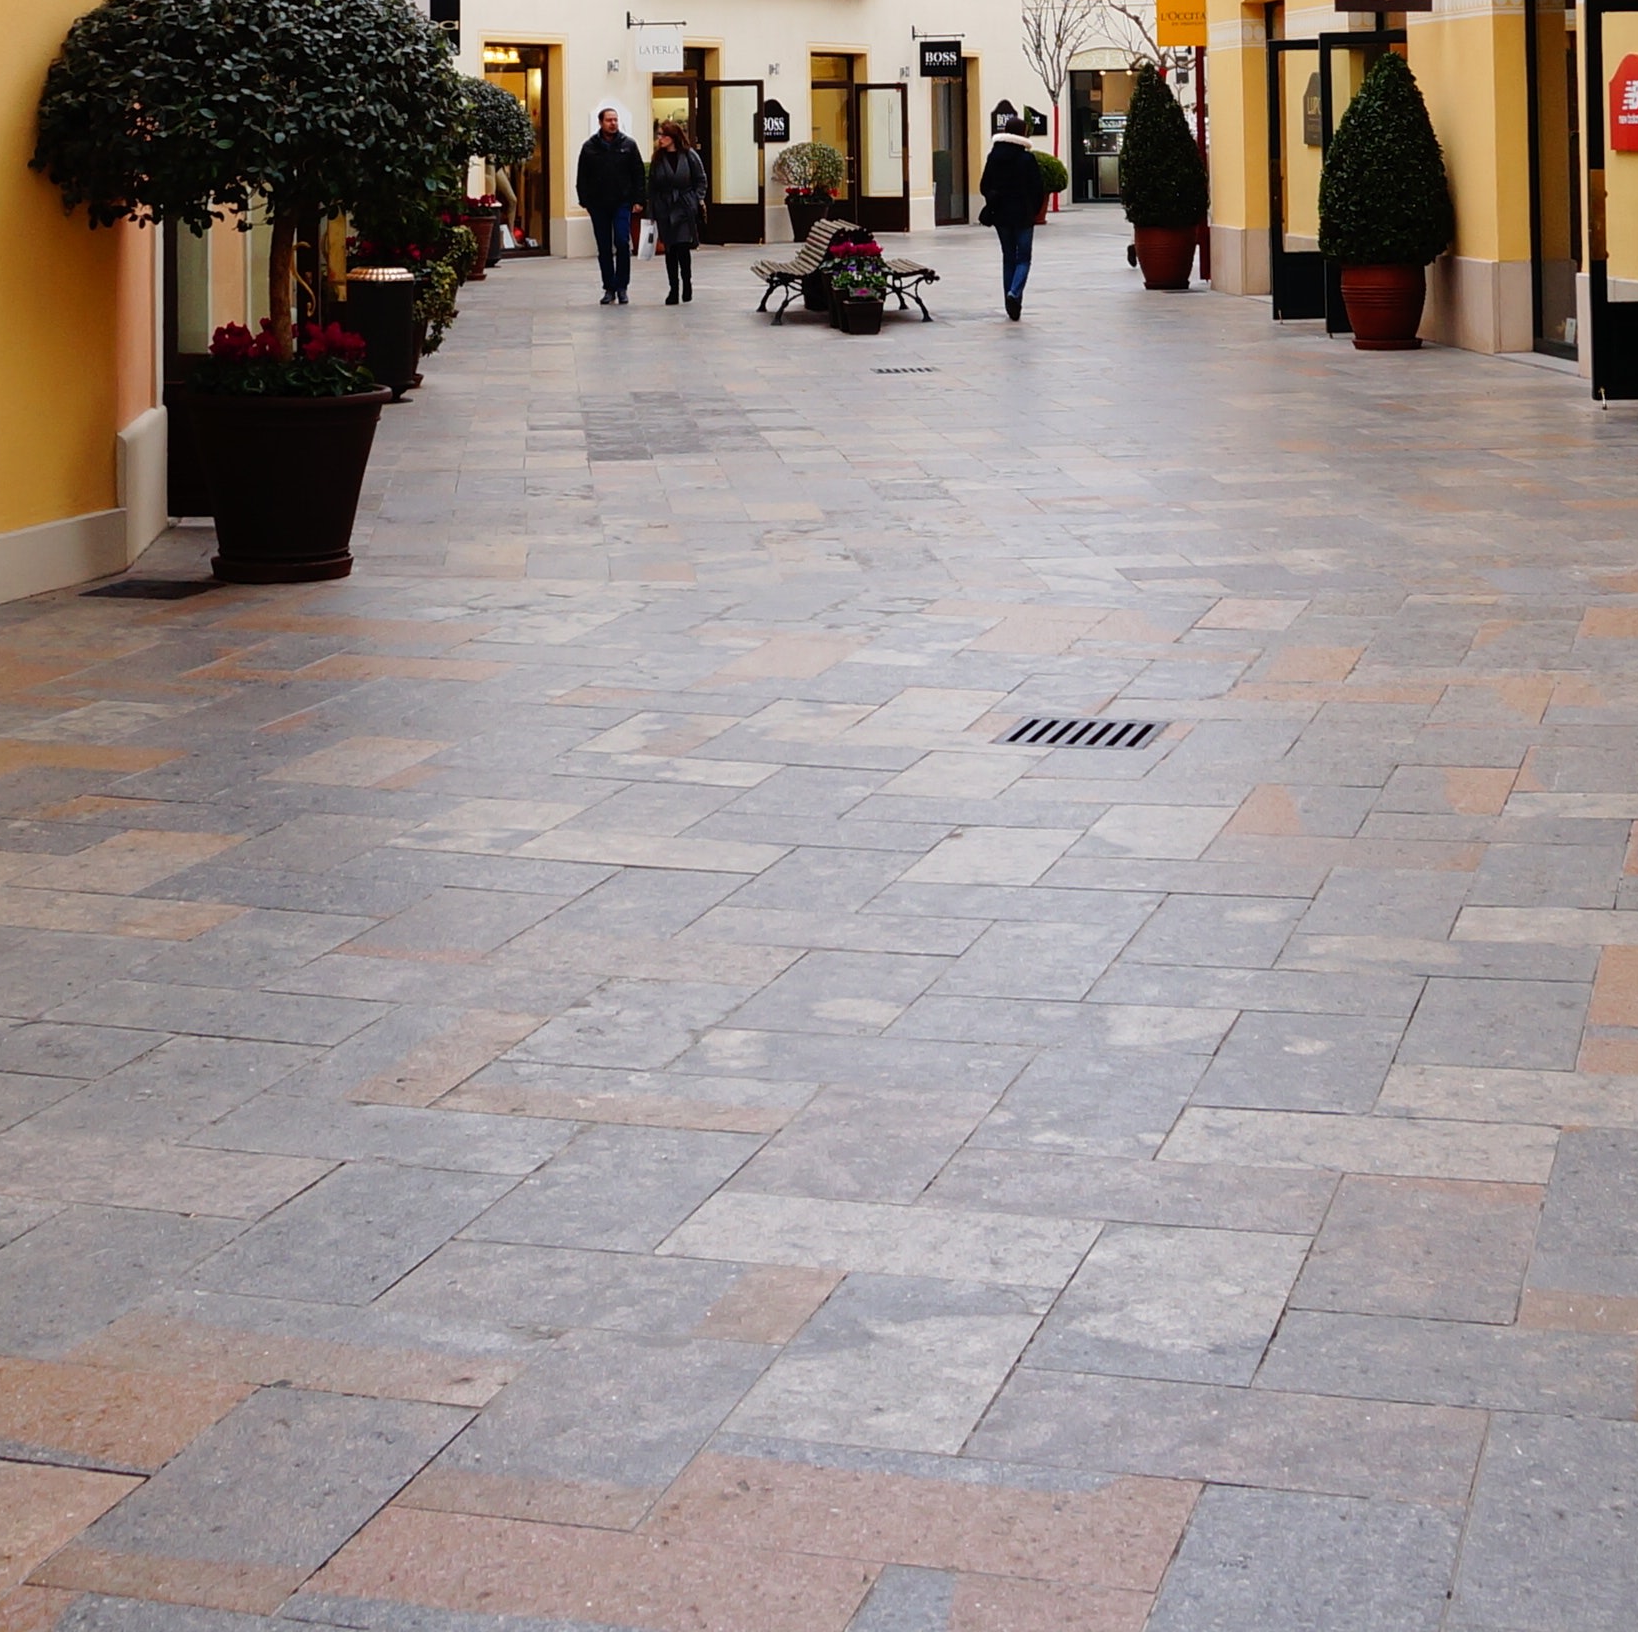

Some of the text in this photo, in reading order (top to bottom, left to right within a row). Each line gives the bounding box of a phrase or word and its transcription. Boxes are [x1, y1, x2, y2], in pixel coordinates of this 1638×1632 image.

[639, 44, 680, 55] LA PERLA
[925, 52, 957, 62] BOSS
